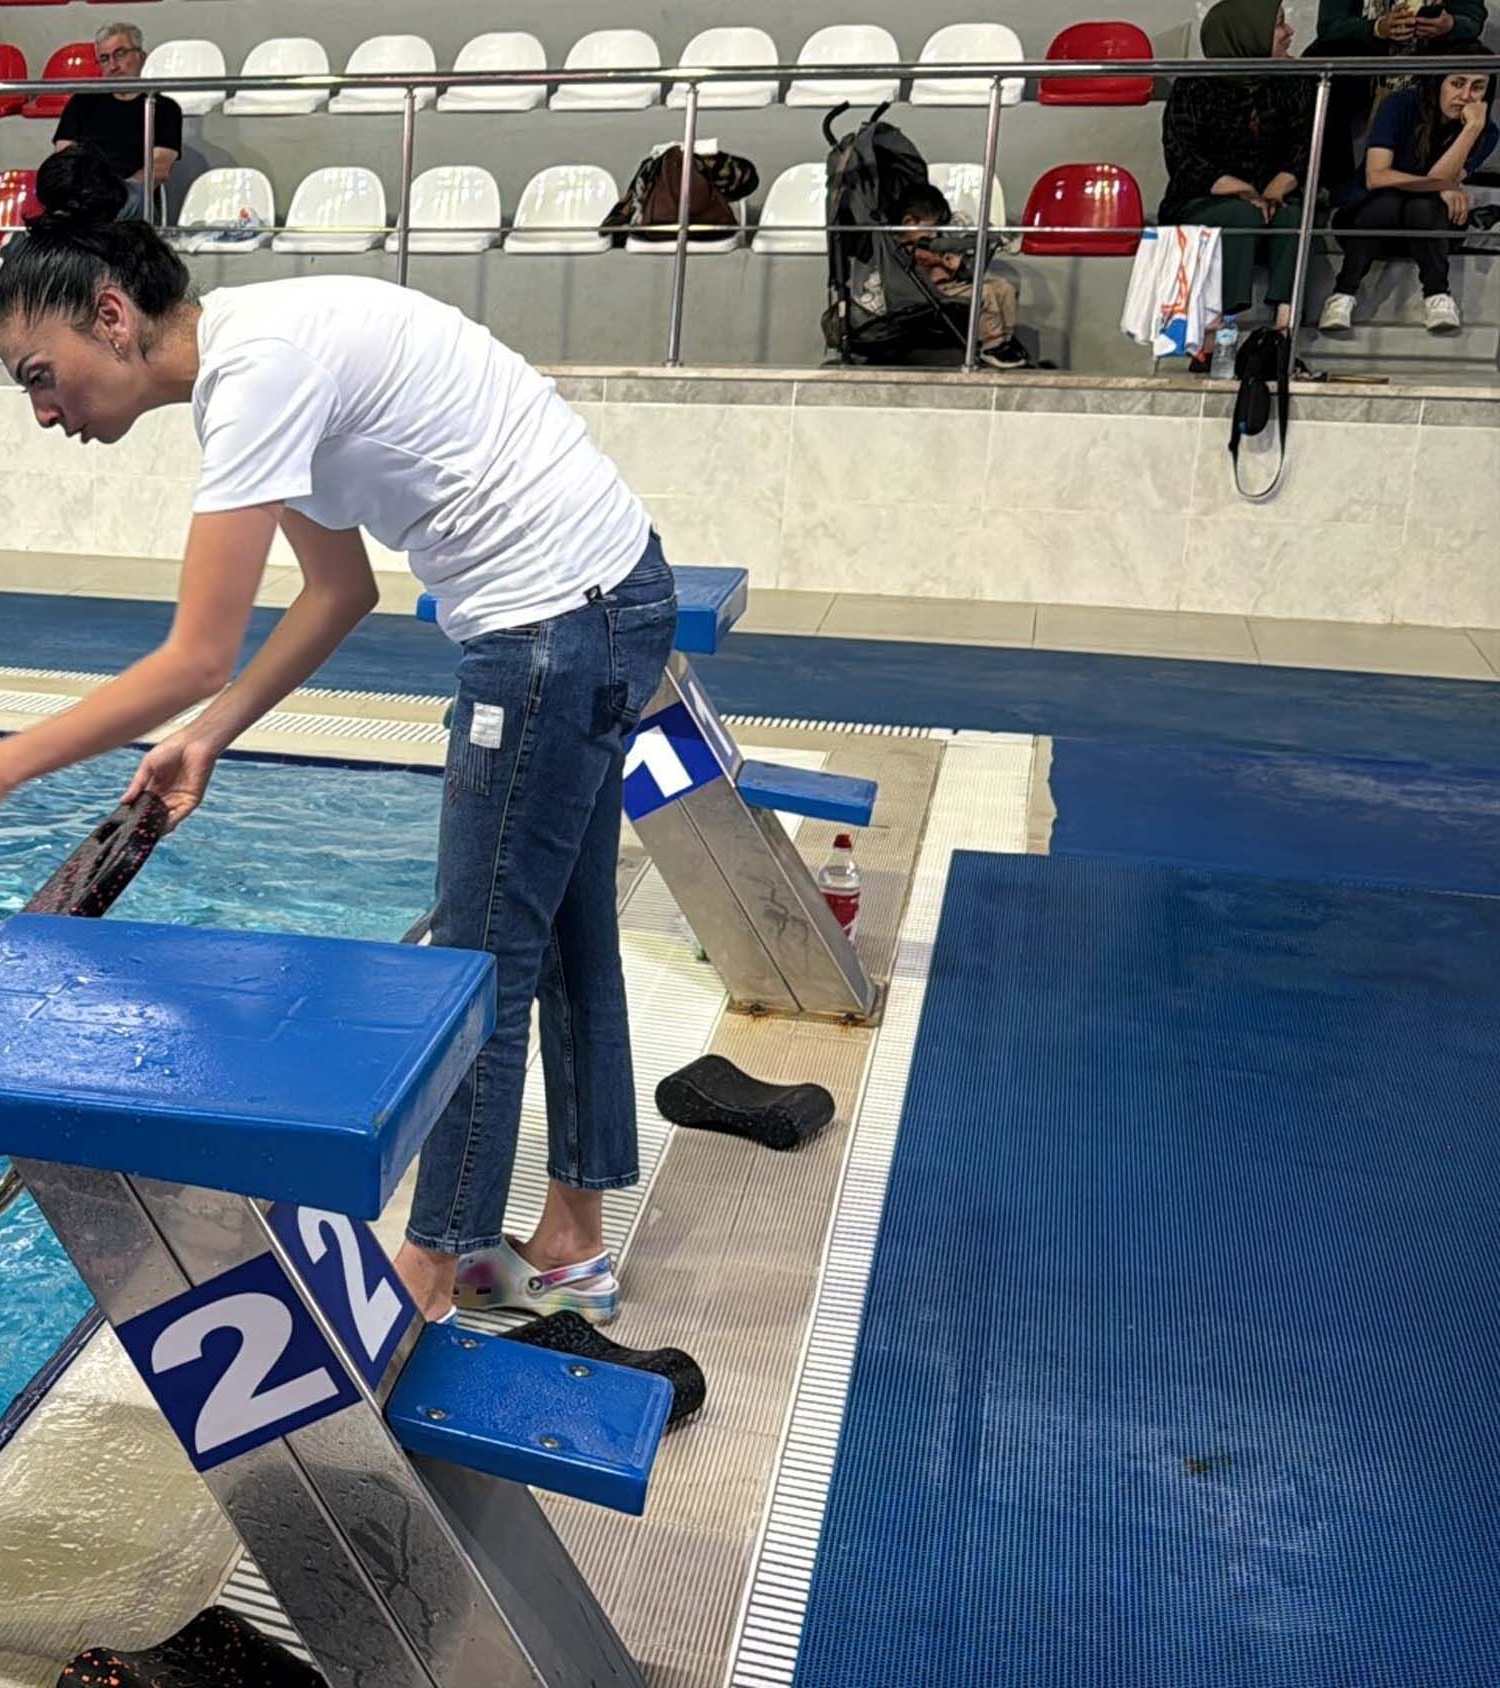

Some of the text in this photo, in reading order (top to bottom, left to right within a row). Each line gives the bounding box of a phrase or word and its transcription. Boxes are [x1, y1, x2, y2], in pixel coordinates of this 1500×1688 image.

[622, 725, 694, 798] 1
[688, 680, 733, 757] 1
[297, 1205, 403, 1363] 2
[151, 1291, 340, 1455] 2
